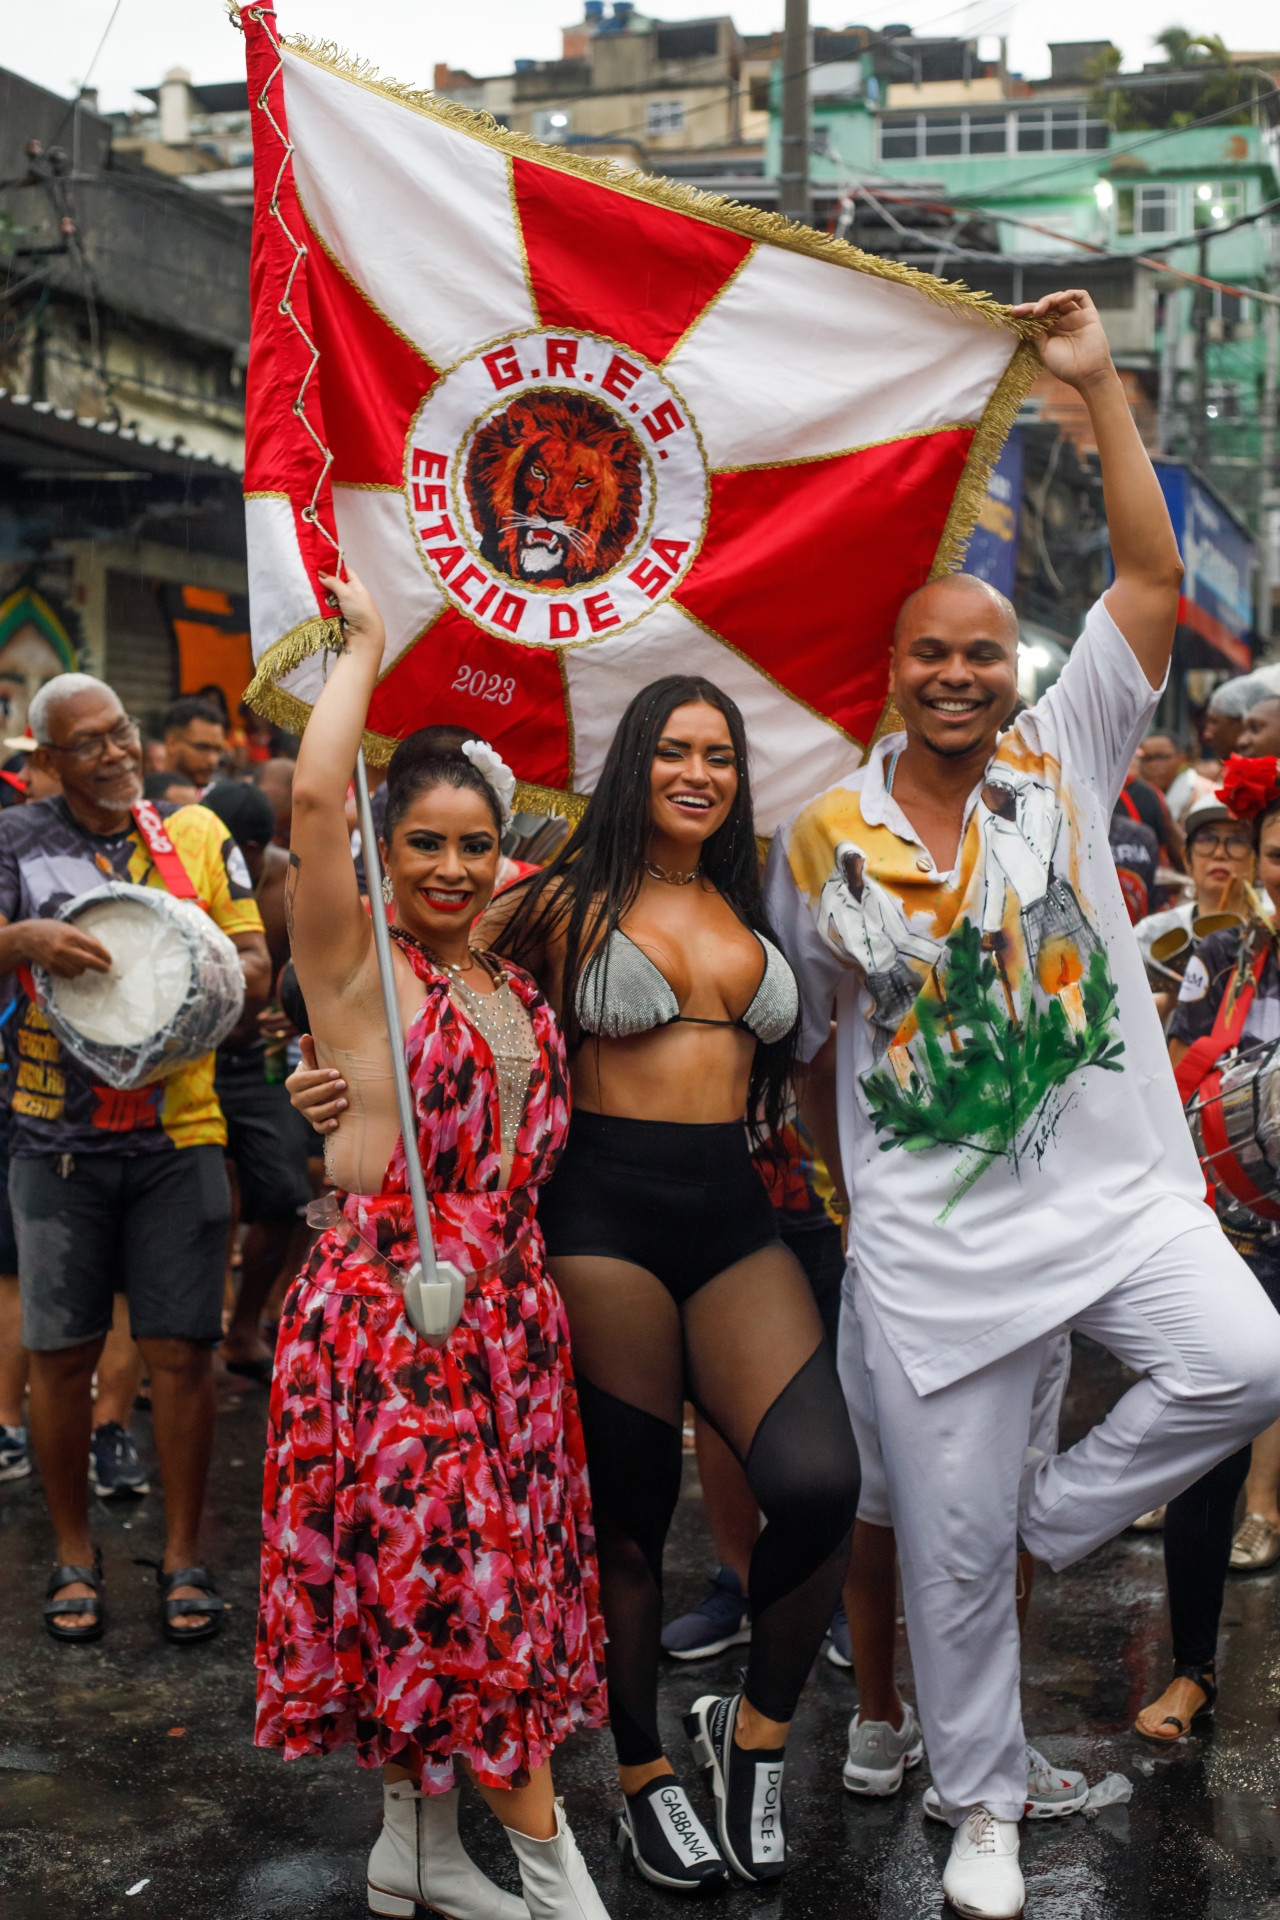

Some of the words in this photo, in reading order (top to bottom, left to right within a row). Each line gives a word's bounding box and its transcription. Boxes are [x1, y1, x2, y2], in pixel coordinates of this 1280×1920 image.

[482, 338, 685, 460] G.R.E.S.
[548, 591, 621, 639] DE
[450, 664, 516, 706] 2023
[660, 1788, 709, 1861] GABBANA
[761, 1769, 781, 1840] DOLCE
[762, 1844, 772, 1854] &
